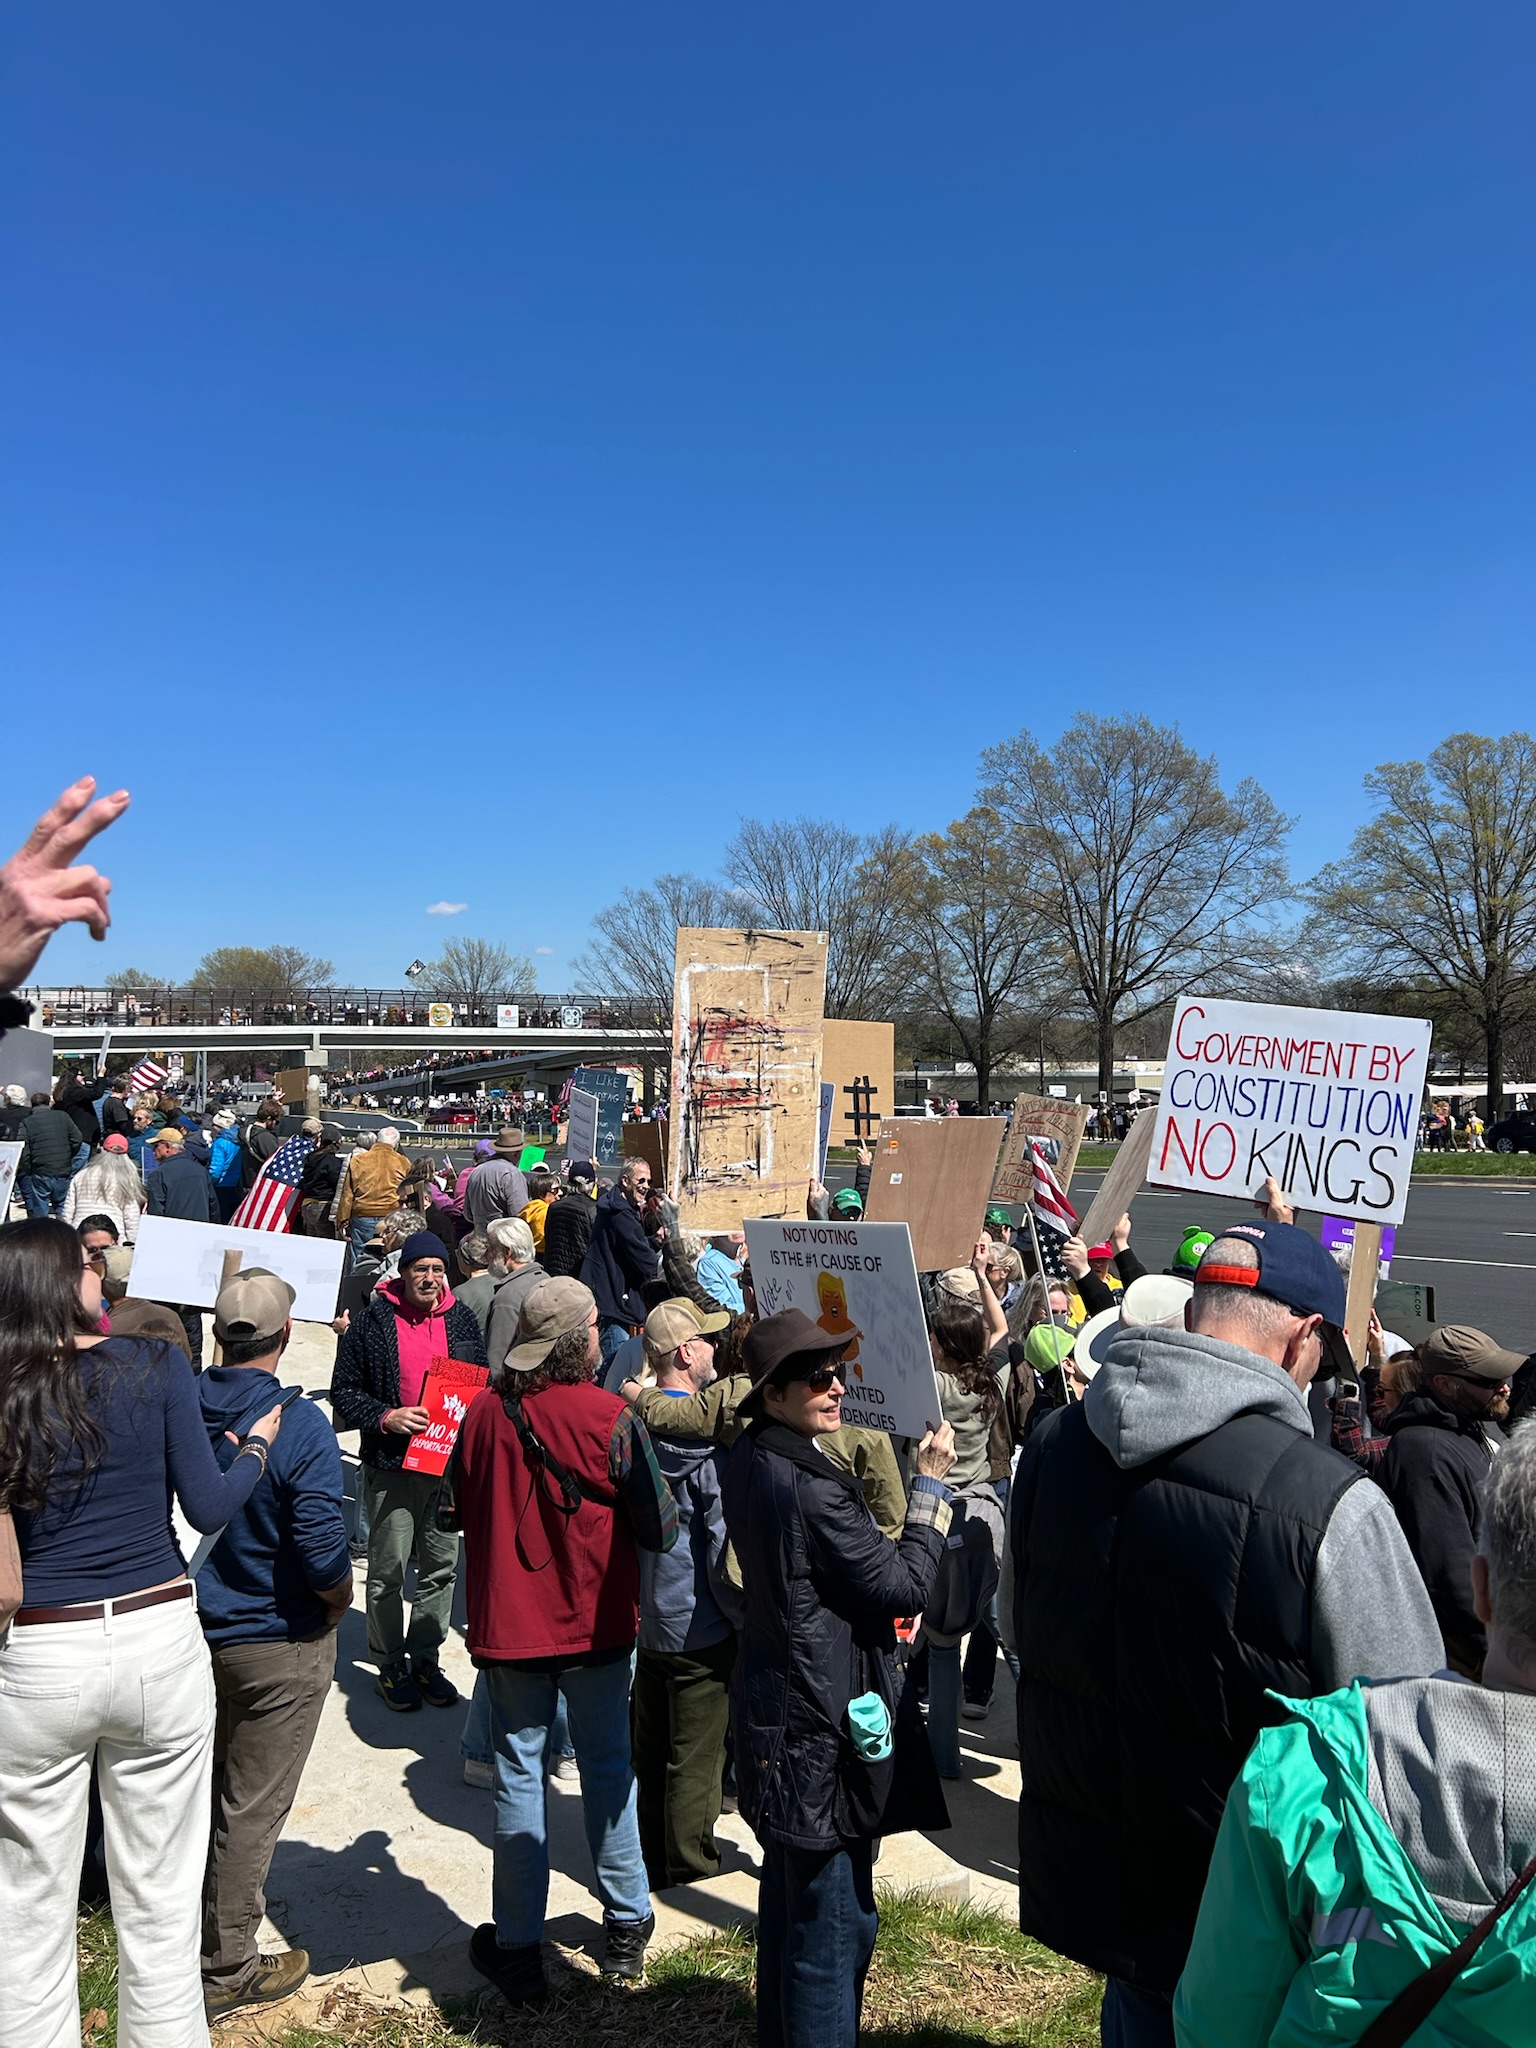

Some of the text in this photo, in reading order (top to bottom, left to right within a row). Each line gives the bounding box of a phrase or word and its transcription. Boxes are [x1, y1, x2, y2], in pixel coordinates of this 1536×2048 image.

[1176, 1005, 1416, 1084] GOVERNMENT BY
[578, 1071, 621, 1089] I LIKE
[1170, 1069, 1414, 1140] CONSTITUTION
[1159, 1115, 1399, 1209] NO KINGS
[782, 1227, 858, 1246] NOT VOTING
[769, 1249, 883, 1273] IS THE #1 CAUSE OF
[759, 1277, 782, 1316] Vote
[425, 1421, 446, 1440] NO
